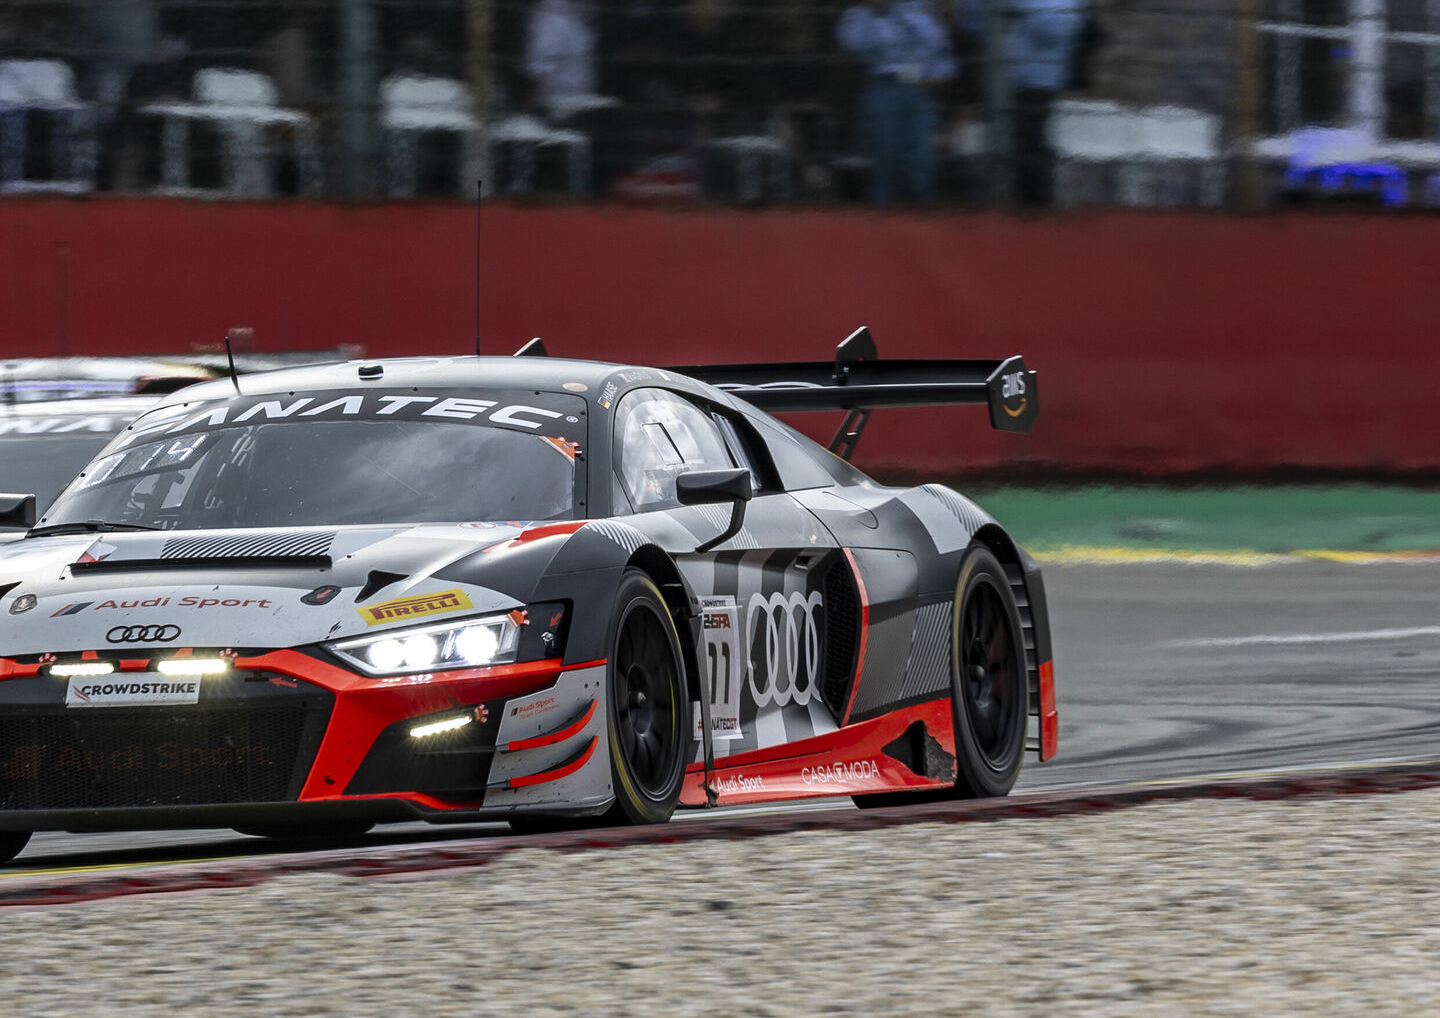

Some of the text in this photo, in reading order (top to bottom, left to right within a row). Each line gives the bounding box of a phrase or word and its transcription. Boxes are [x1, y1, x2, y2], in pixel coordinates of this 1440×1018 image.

[94, 596, 272, 610] Audi Sport
[369, 593, 461, 620] PIRELLI
[81, 683, 197, 696] CROWDSTRIKE
[716, 773, 766, 793] Audi Sport
